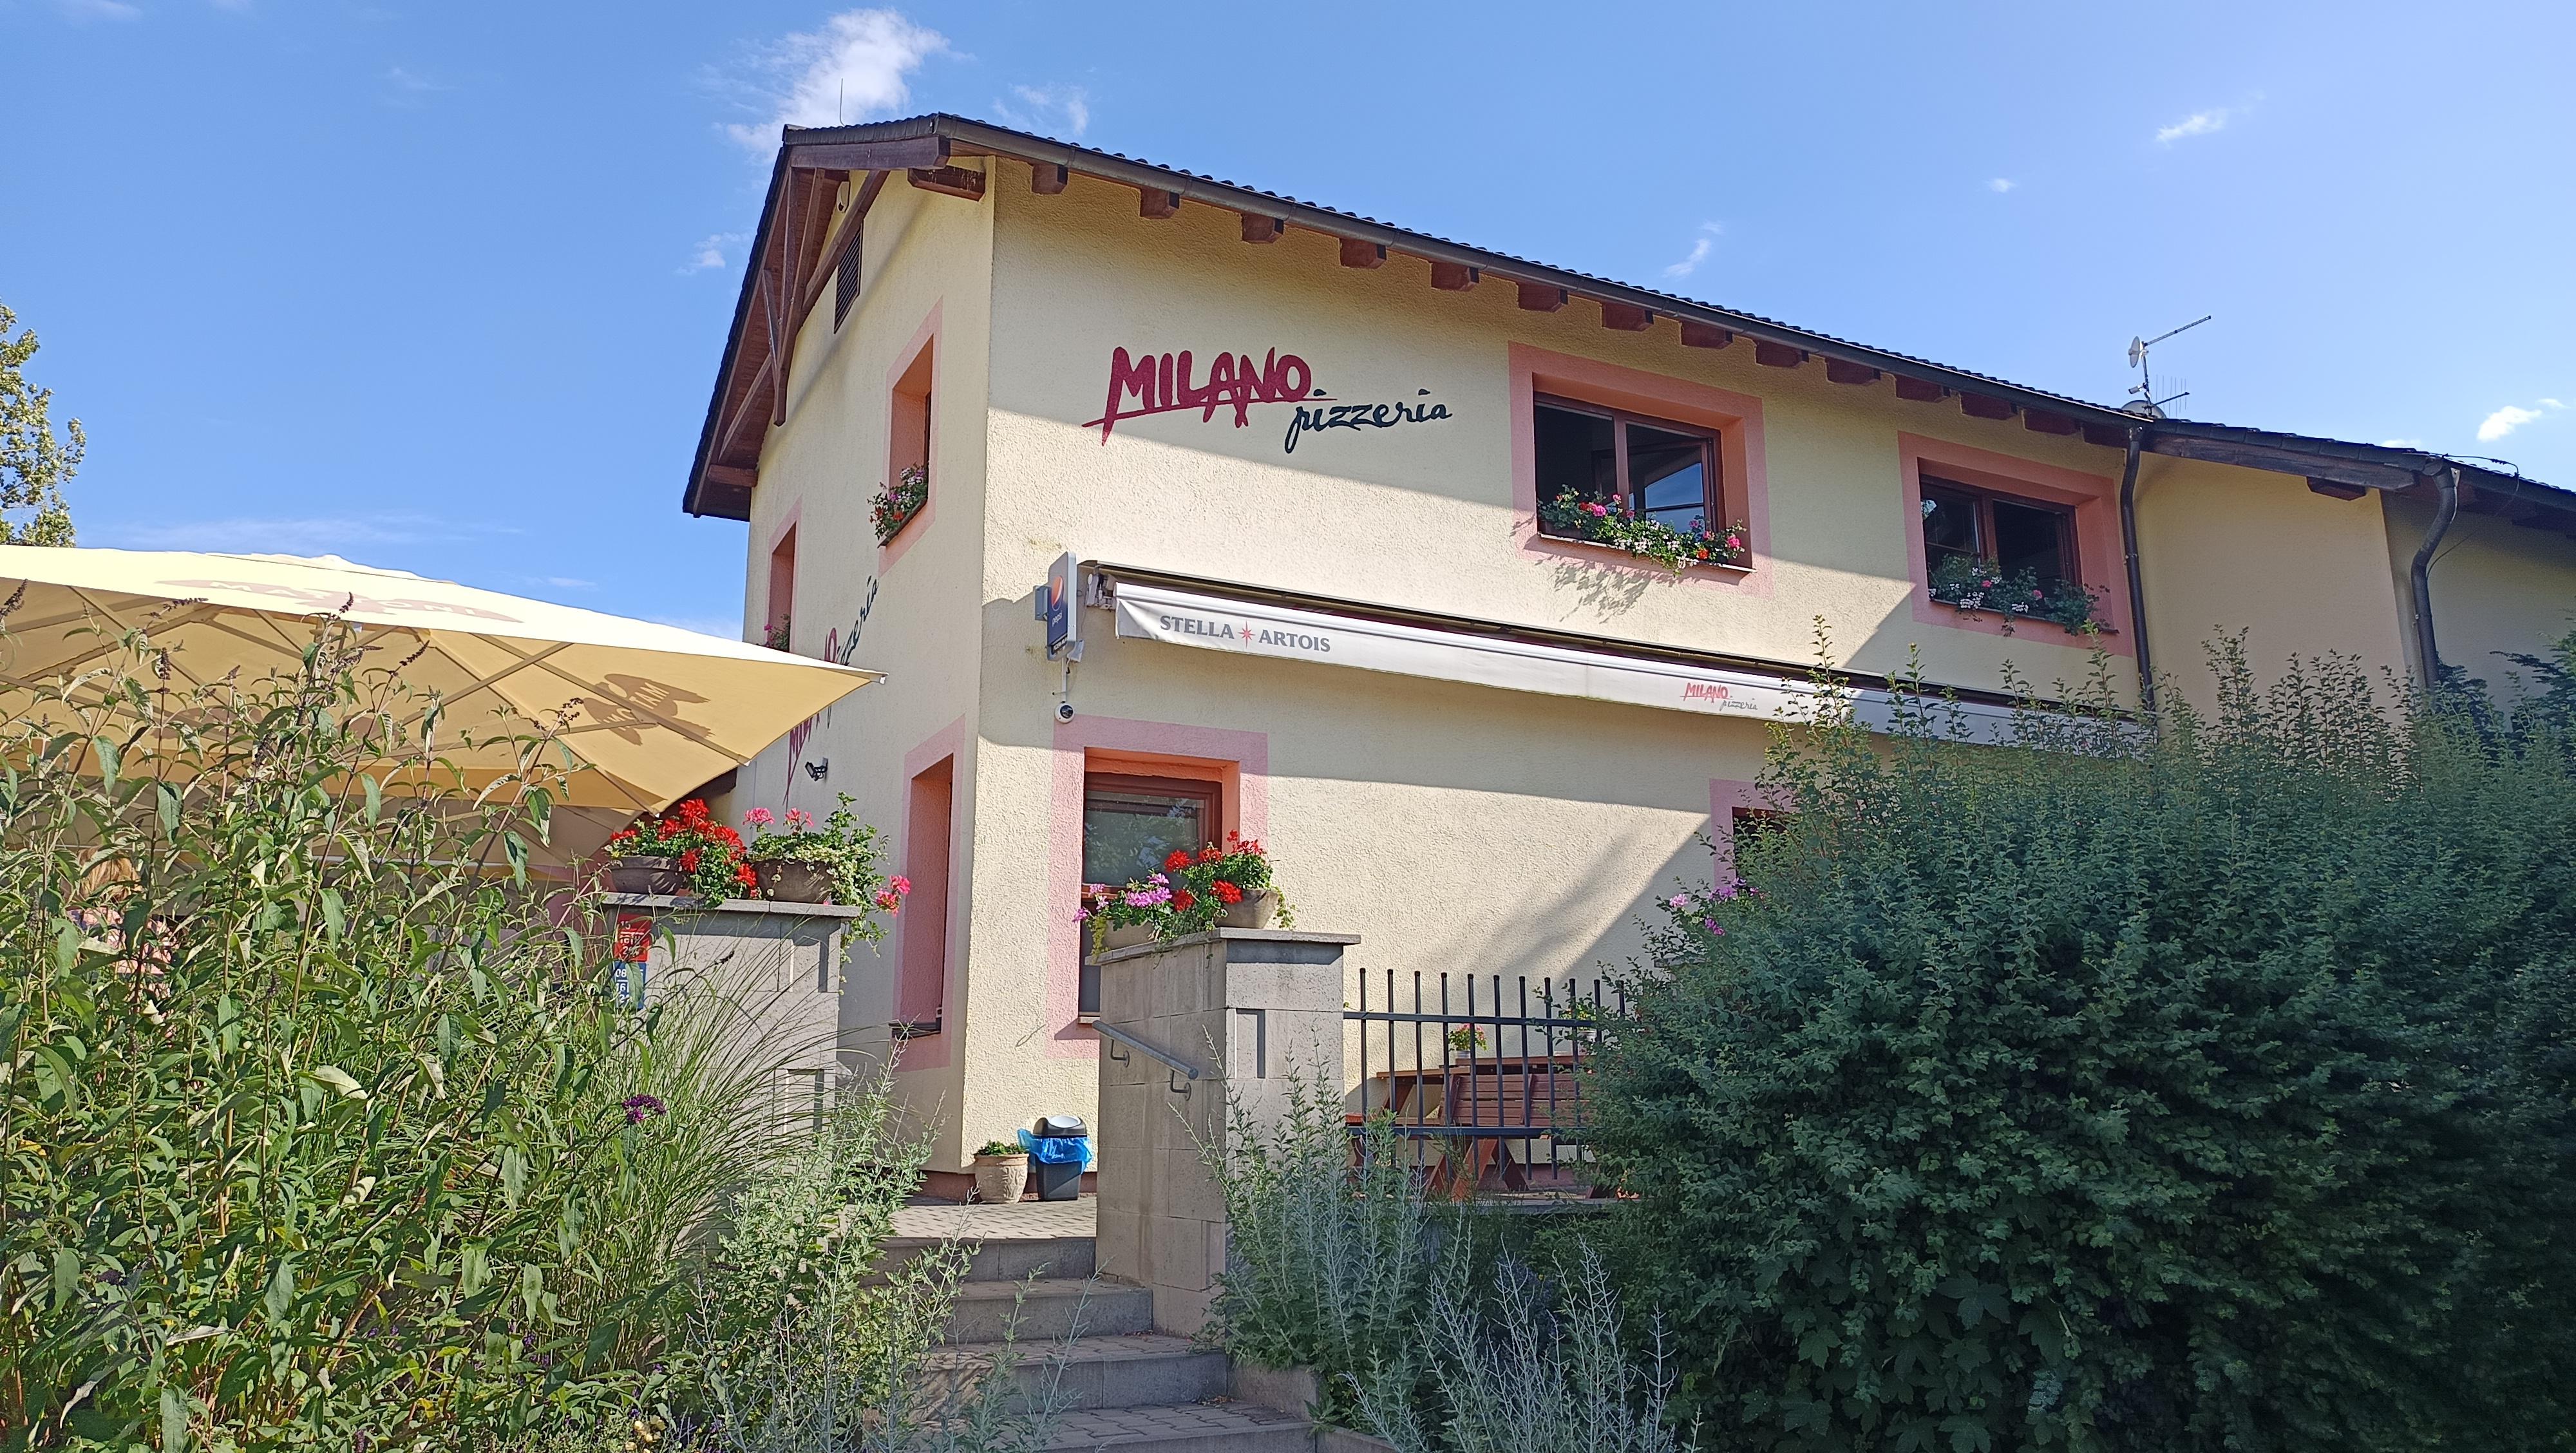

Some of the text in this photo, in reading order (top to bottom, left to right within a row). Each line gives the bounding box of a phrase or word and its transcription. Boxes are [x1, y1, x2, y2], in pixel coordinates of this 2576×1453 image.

[1082, 347, 1337, 446] MILANO
[1285, 388, 1453, 453] pizzeria
[1160, 615, 1331, 652] STELLA ARTOIS
[1680, 682, 1734, 703] MILANO
[1719, 696, 1758, 712] pizzeria
